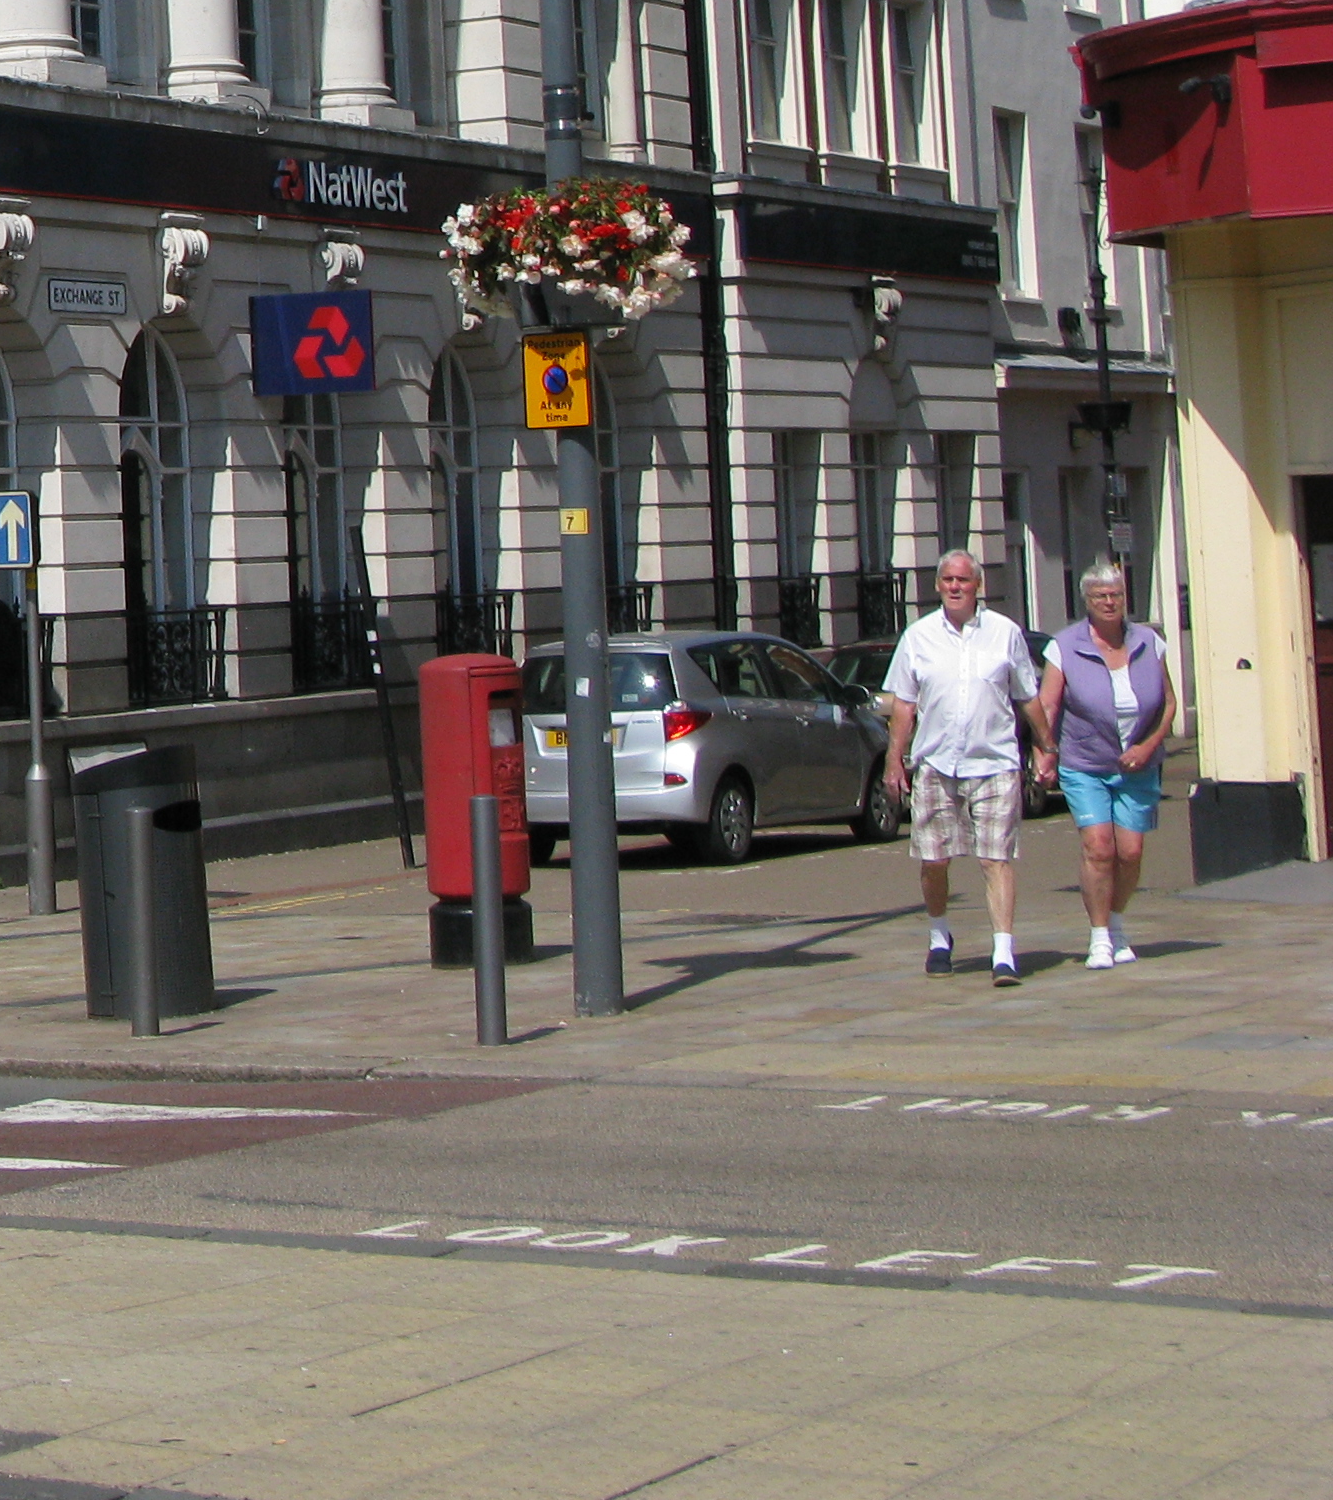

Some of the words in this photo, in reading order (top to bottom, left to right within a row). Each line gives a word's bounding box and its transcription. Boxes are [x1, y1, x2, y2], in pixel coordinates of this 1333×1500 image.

[307, 160, 409, 213] NatWest
[53, 287, 104, 305] EXCHANGE
[527, 339, 581, 350] Pedestrian
[542, 351, 566, 361] Zone
[540, 401, 553, 411] At
[555, 402, 573, 412] any
[546, 412, 569, 423] time
[565, 516, 575, 531] 7
[811, 1095, 1173, 1123] RIGHT
[354, 1220, 727, 1256] LOOK
[749, 1244, 1220, 1289] LEFT
